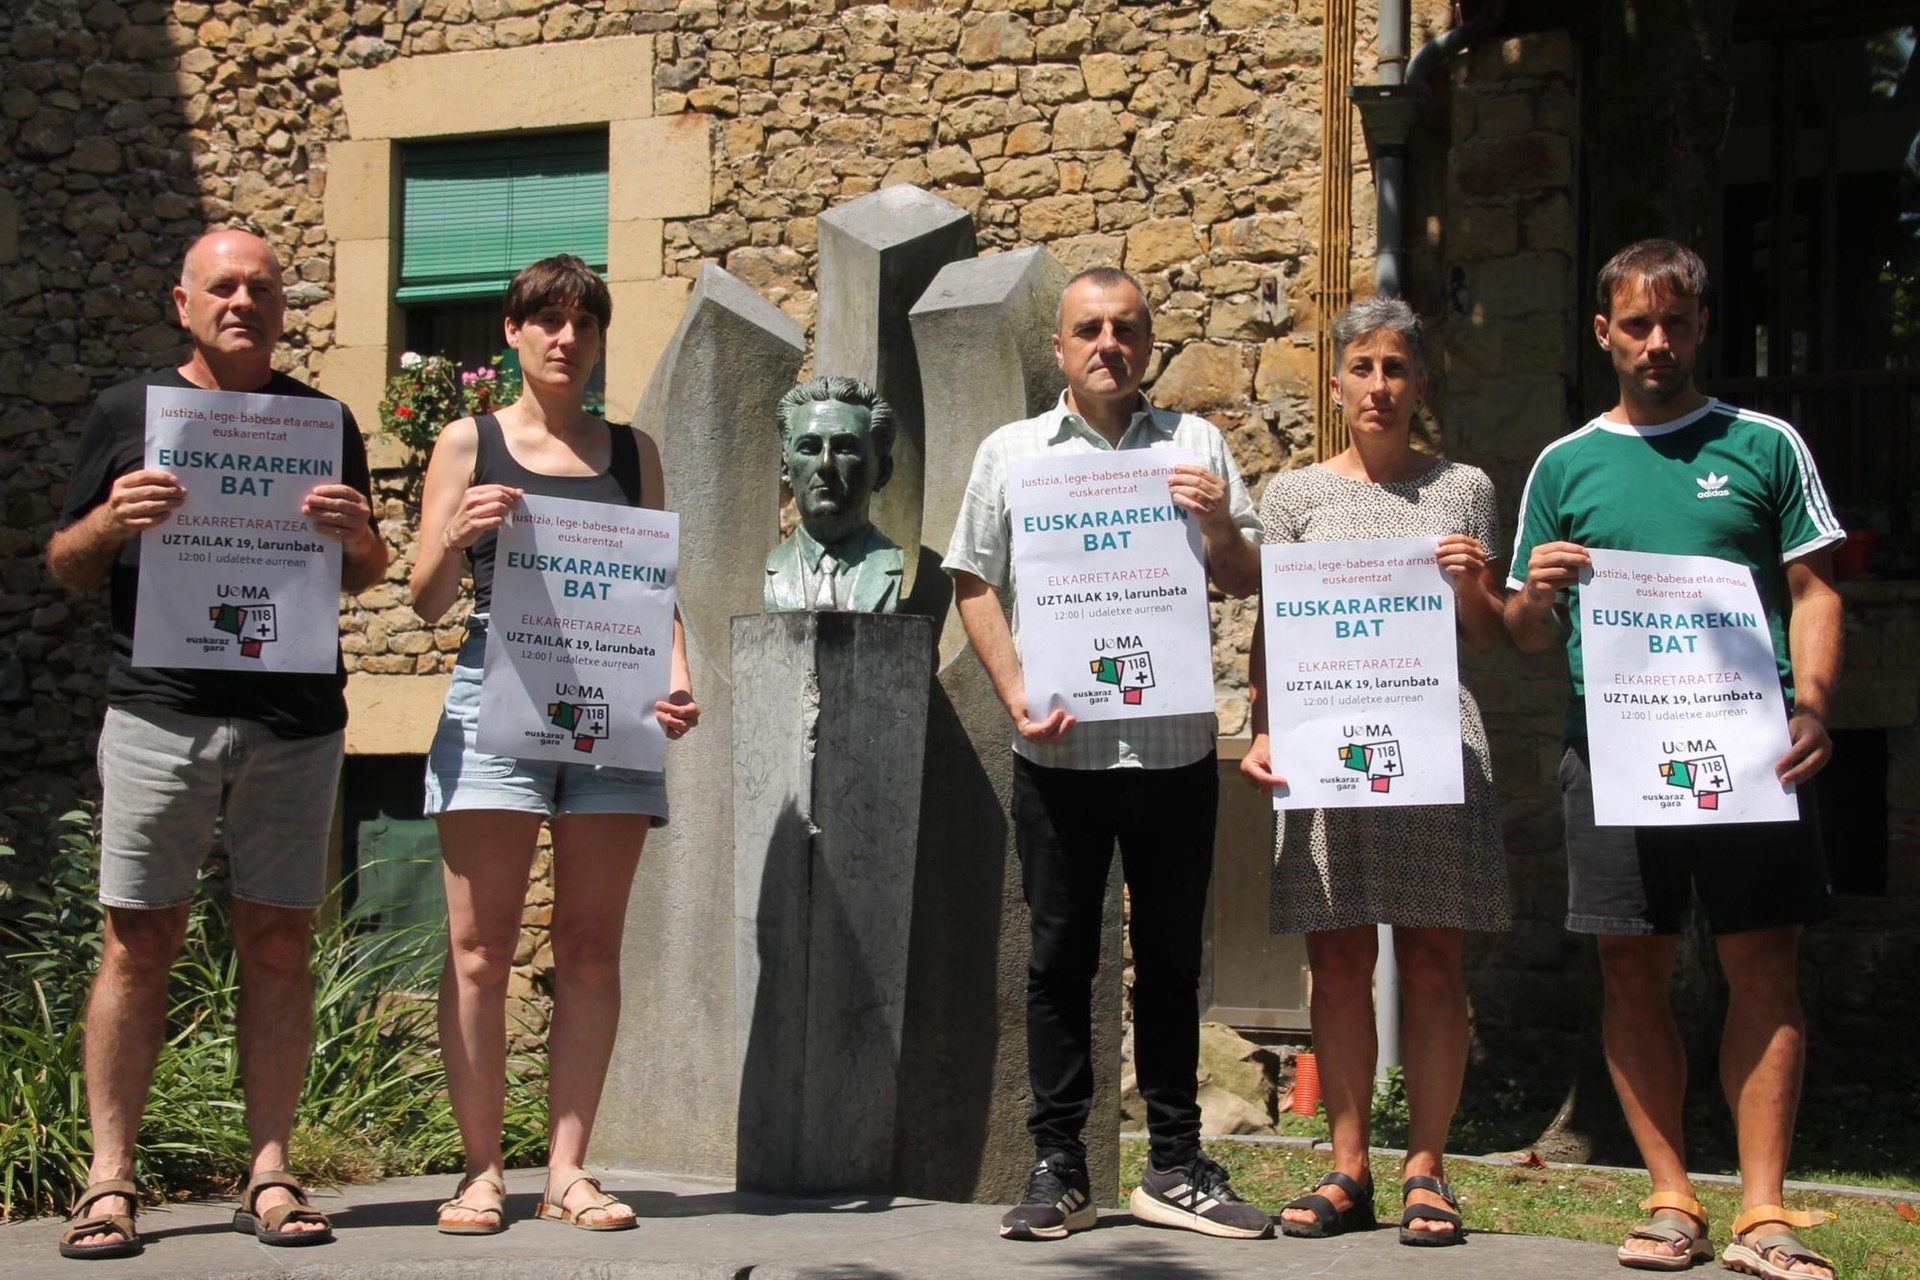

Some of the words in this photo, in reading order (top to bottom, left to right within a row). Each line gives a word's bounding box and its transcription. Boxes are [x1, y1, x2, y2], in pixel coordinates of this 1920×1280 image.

[161, 407, 207, 421] Justizia,
[210, 410, 280, 426] lege-babesa
[283, 416, 300, 426] eta
[302, 419, 334, 429] arnasa
[213, 428, 287, 441] euskarentzat
[159, 450, 332, 476] EUSKARAREKIN
[1022, 475, 1062, 488] Justizia,
[1065, 470, 1130, 485] lege-babesa
[1132, 468, 1148, 477] eta
[1151, 466, 1174, 476] arna
[221, 476, 274, 496] BAT
[1069, 484, 1137, 498] euskarentzat
[1697, 489, 1730, 499] adidas
[178, 515, 308, 531] ELKARRETARATZEA
[512, 512, 553, 527] Justizia,
[556, 517, 618, 533] lege-babesa
[620, 524, 635, 534] eta
[637, 527, 669, 539] arnasa
[1024, 505, 1188, 532] EUSKARAREKIN
[162, 534, 232, 548] UZTAILAK
[258, 539, 324, 552] larunbata
[558, 533, 623, 548] euskarentzat
[1084, 531, 1131, 551] BAT
[178, 553, 205, 562] 12:00
[216, 554, 262, 564] udaletxe
[266, 558, 306, 568] aurrean
[508, 552, 666, 583] EUSKARAREKIN
[1275, 562, 1316, 573] Justizia,
[1318, 558, 1384, 572] lege-babesa
[1387, 558, 1404, 566] eta
[1406, 556, 1436, 566] arnas
[1048, 568, 1169, 586] ELKARRETARATZEA
[1322, 573, 1392, 584] euskarentzat
[1633, 571, 1694, 584] lege-babesa
[1697, 575, 1714, 584] eta
[564, 580, 611, 600] BAT
[1037, 592, 1102, 606] UZTAILAK
[1125, 586, 1187, 600] larunbata
[1636, 588, 1702, 598] euskarentzat
[1054, 610, 1079, 620] 12:00
[1089, 606, 1132, 618] udaletxe
[1135, 603, 1172, 614] aurrean
[1276, 595, 1442, 617] EUSKARAREKIN
[522, 614, 642, 635] ELKARRETARATZEA
[1593, 609, 1757, 629] EUSKARAREKIN
[1336, 620, 1384, 638] BAT
[186, 637, 229, 645] euskaraz
[507, 632, 573, 649] UZTAILAK
[596, 639, 655, 656] larunbata
[1649, 635, 1697, 653] BAT
[522, 651, 546, 660] 12:00
[557, 655, 600, 667] udaletxe
[602, 659, 639, 670] aurrean
[1299, 658, 1422, 672] ELKARRETARATZEA
[1286, 679, 1353, 691] UZTAILAK
[1376, 676, 1439, 688] larunbata
[1615, 672, 1742, 686] ELKARRETARATZEA
[1073, 689, 1112, 698] euskaraz
[1090, 696, 1108, 704] gara
[1303, 697, 1328, 706] 12:00
[1338, 695, 1382, 705] udaletxe
[1385, 693, 1423, 704] aurrean
[1604, 693, 1670, 704] UZTAILAK
[1694, 691, 1762, 703] larunbata
[1621, 711, 1646, 720] 12:00
[1656, 710, 1703, 720] udaletxe
[1705, 708, 1747, 718] aurrean
[525, 731, 564, 740] euskaraz
[1337, 783, 1356, 791] gara
[1660, 800, 1681, 808] gara
